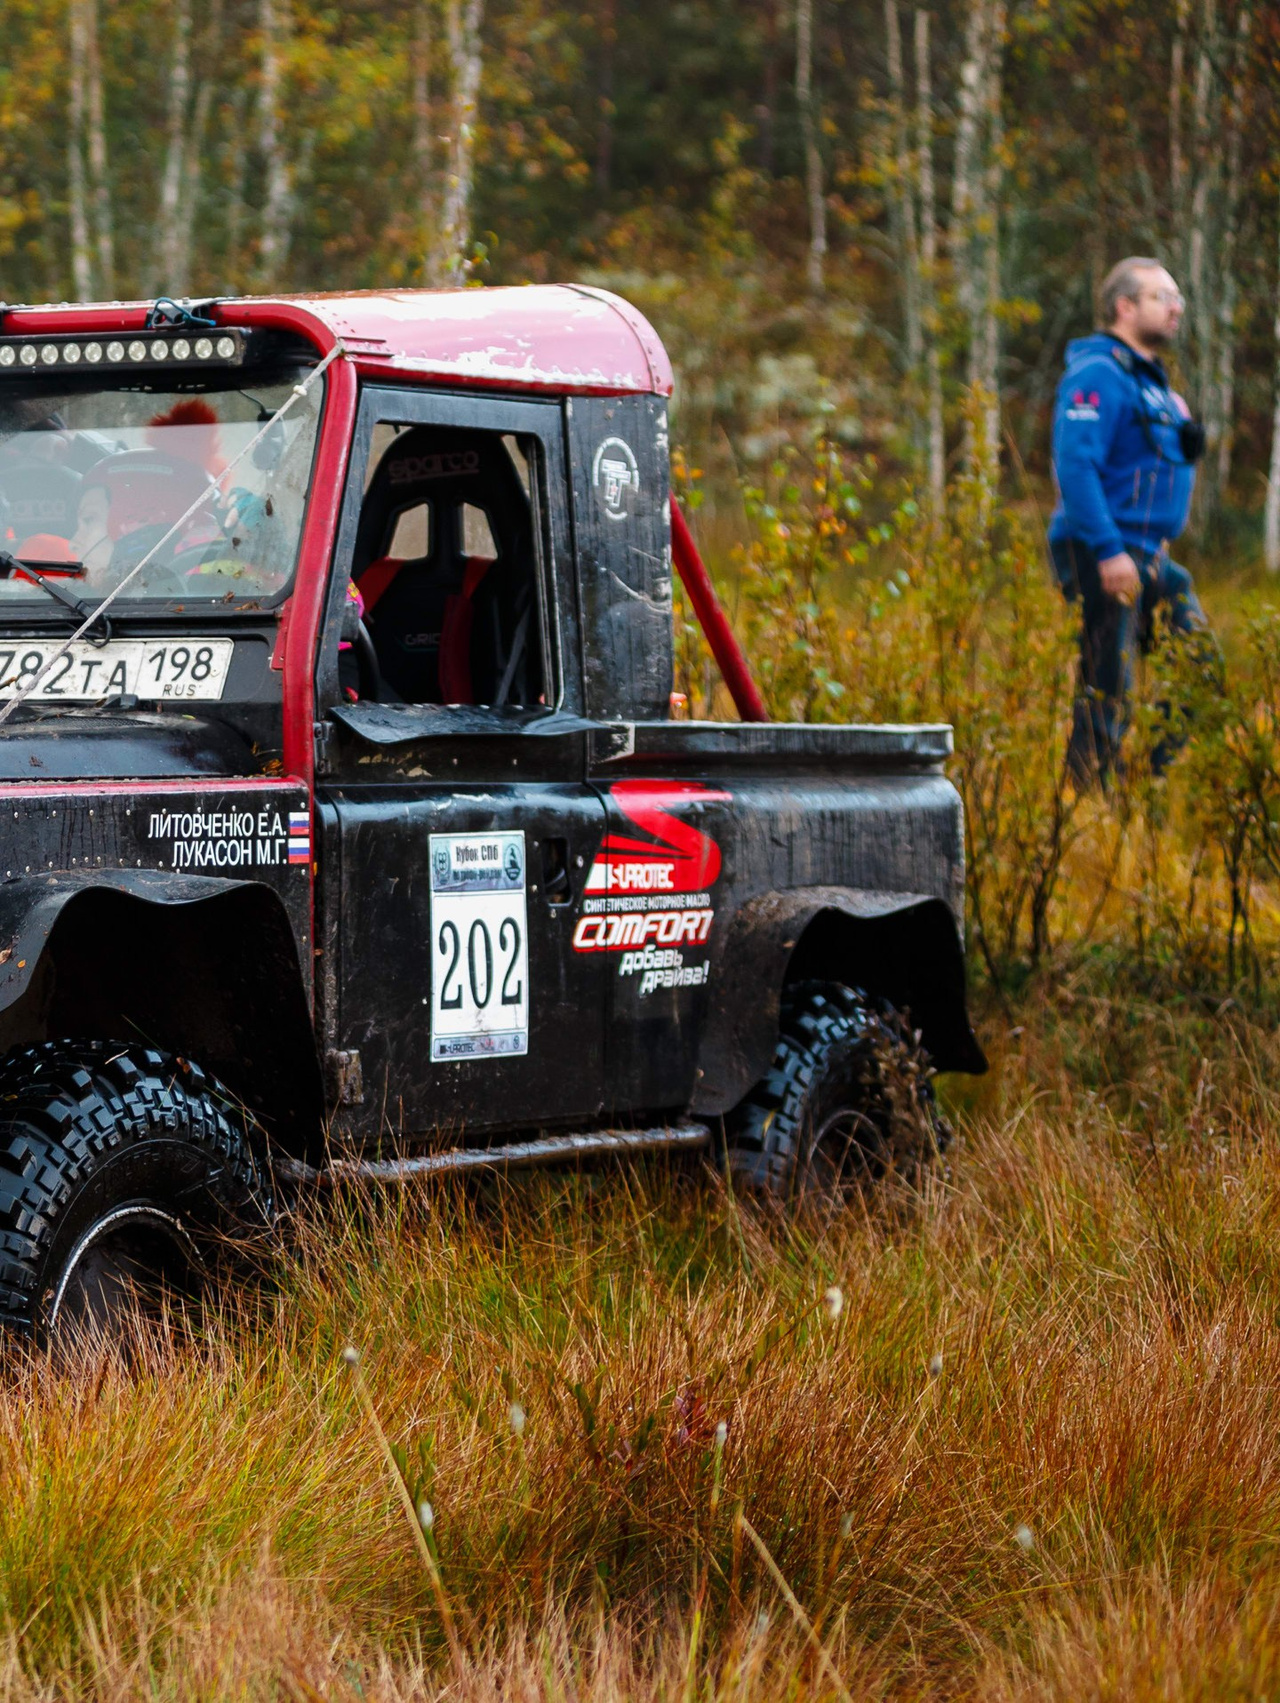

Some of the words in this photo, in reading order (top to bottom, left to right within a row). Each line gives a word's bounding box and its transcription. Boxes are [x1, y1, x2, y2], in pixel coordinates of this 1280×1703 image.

[388, 451, 478, 481] sparco
[149, 646, 214, 682] 198
[162, 684, 197, 697] RUS
[147, 812, 254, 838] ЛИТОВЧЕНКО
[257, 812, 287, 837] Е.А.
[171, 839, 253, 867] ЛУКАСОН
[256, 839, 287, 864] М.Г.
[455, 845, 479, 864] Кубок
[481, 844, 499, 861] СПб
[583, 897, 647, 913] СИНТЕТИЧЕСКОЕ
[648, 895, 685, 911] МОТОРНОЕ
[686, 893, 711, 908] МАСЛО
[573, 909, 715, 949] COMFORT
[438, 916, 522, 1010] 202
[619, 944, 683, 976] добавь
[639, 959, 710, 994] драйва!
